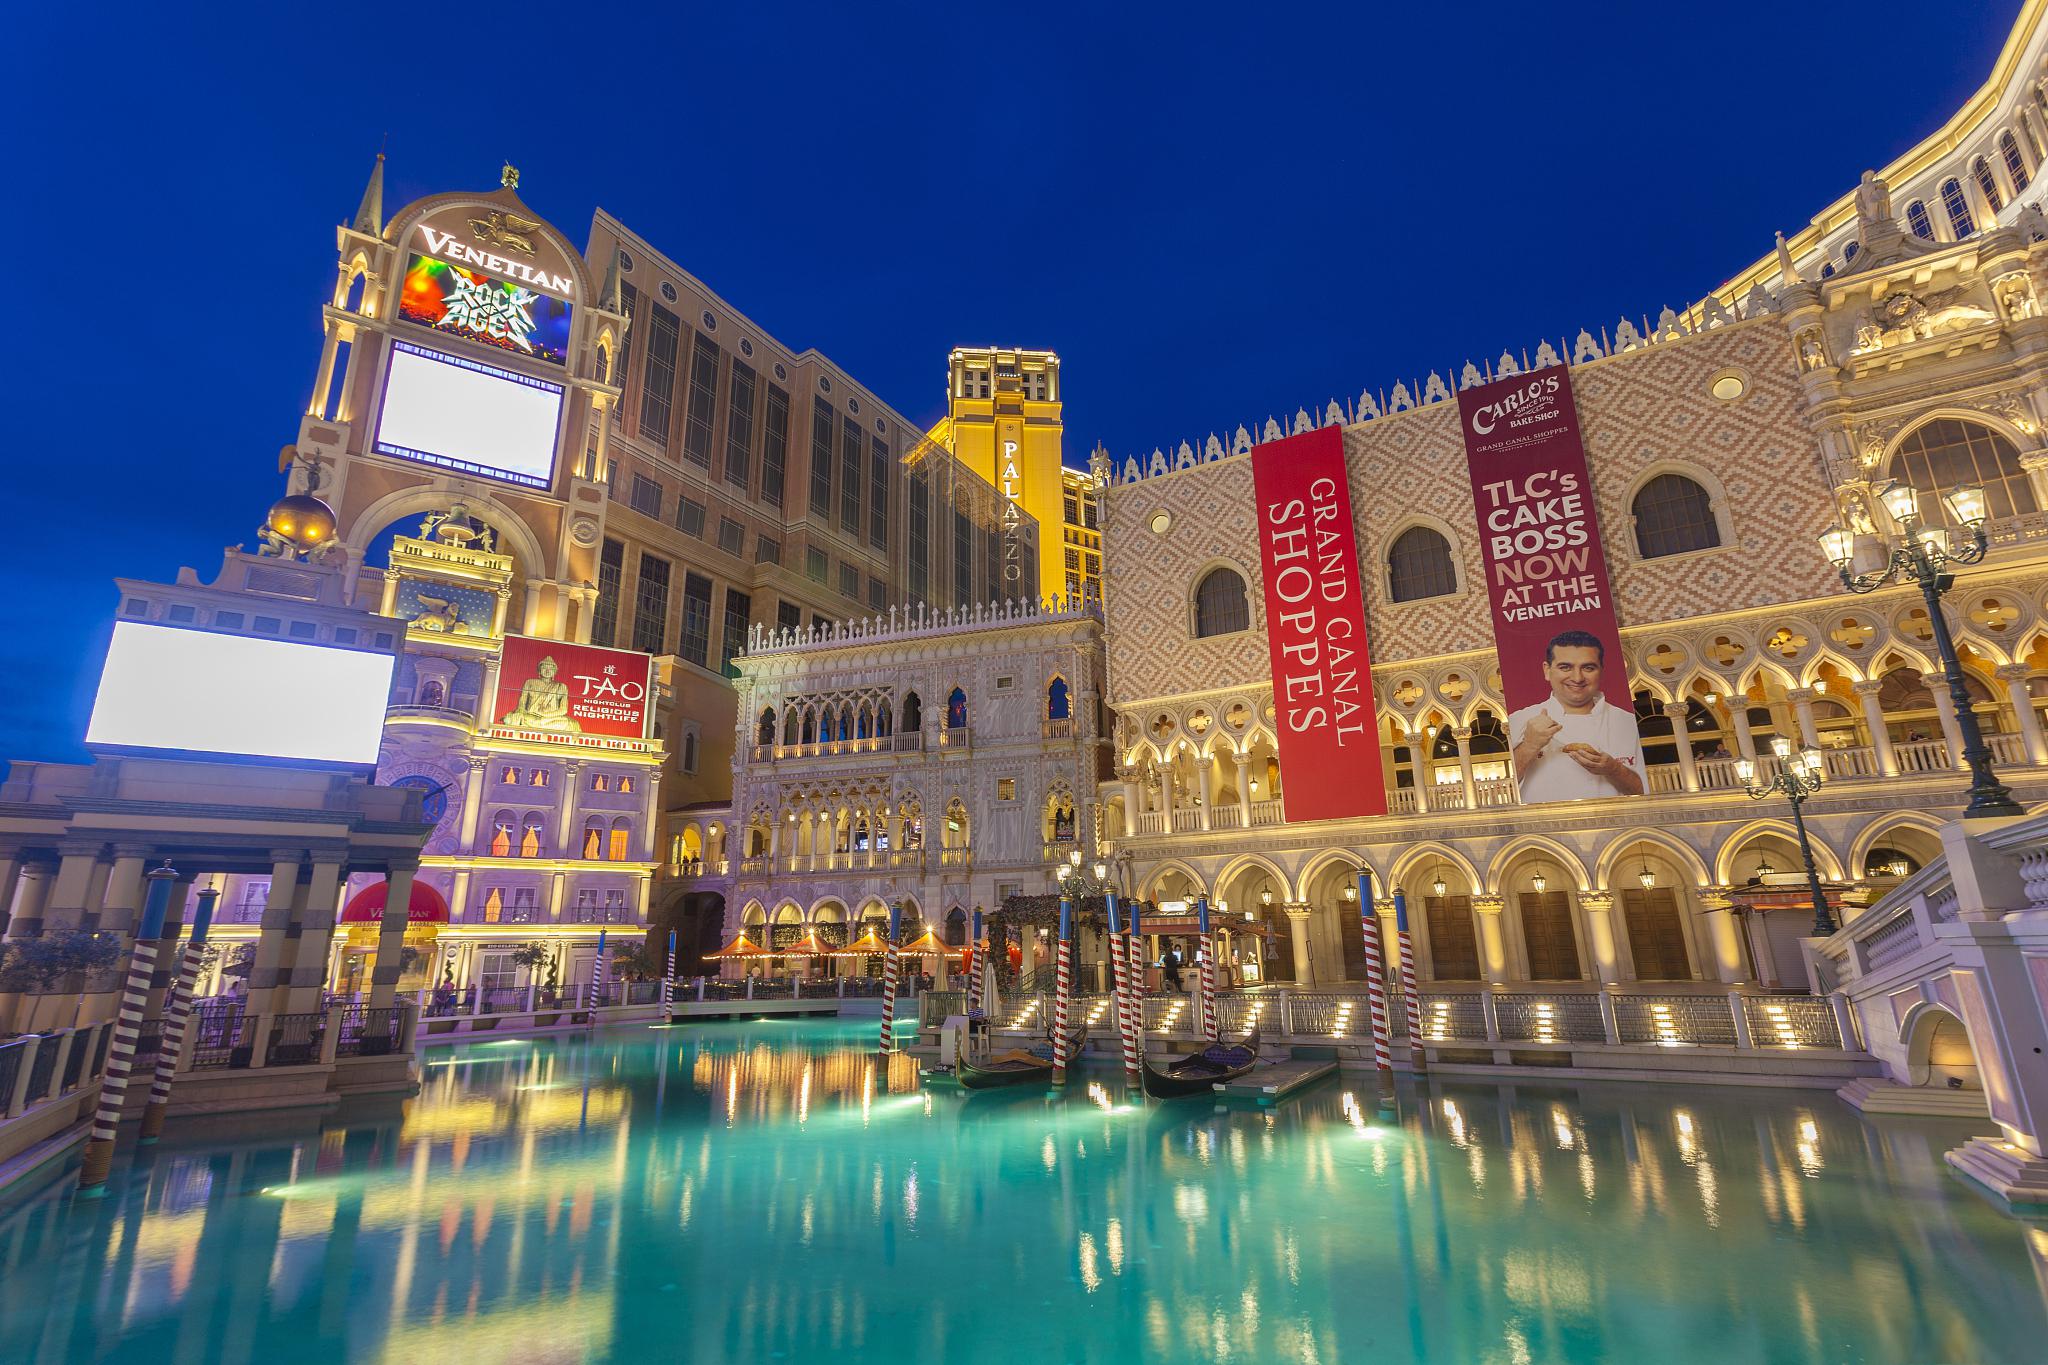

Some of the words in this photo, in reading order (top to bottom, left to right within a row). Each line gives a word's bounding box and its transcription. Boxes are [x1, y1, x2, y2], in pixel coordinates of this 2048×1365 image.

[417, 224, 573, 295] VENETIAN
[441, 266, 539, 331] ROCK
[482, 304, 498, 315] OF
[437, 300, 534, 353] AGES
[1472, 375, 1560, 435] CARLO'S
[1510, 416, 1534, 428] BAKE
[1535, 410, 1560, 422] SHOP
[1517, 398, 1538, 414] SINCE
[1538, 395, 1555, 403] 1910
[1476, 441, 1504, 453] GRAND
[1505, 434, 1533, 446] CANAL
[1533, 426, 1569, 440] SHOPPES
[1482, 469, 1578, 507] TLC's
[1002, 440, 1021, 581] PALAZZO
[1487, 493, 1585, 533] CAKE
[1310, 477, 1348, 603] GRAND
[1491, 520, 1589, 561] BOSS
[1495, 546, 1590, 587] NOW
[1502, 584, 1534, 608] AT
[1541, 574, 1598, 598] THE
[1503, 595, 1601, 623] VENETIAN
[1268, 499, 1327, 733] SHOPPES
[573, 675, 644, 702] TAO
[1325, 616, 1364, 748] CANAL
[573, 704, 640, 717] RELIGIOUS
[573, 710, 638, 723] NIGHTLIFE
[584, 698, 631, 708] NIGHTCLUB
[369, 907, 430, 918] VEIAN
